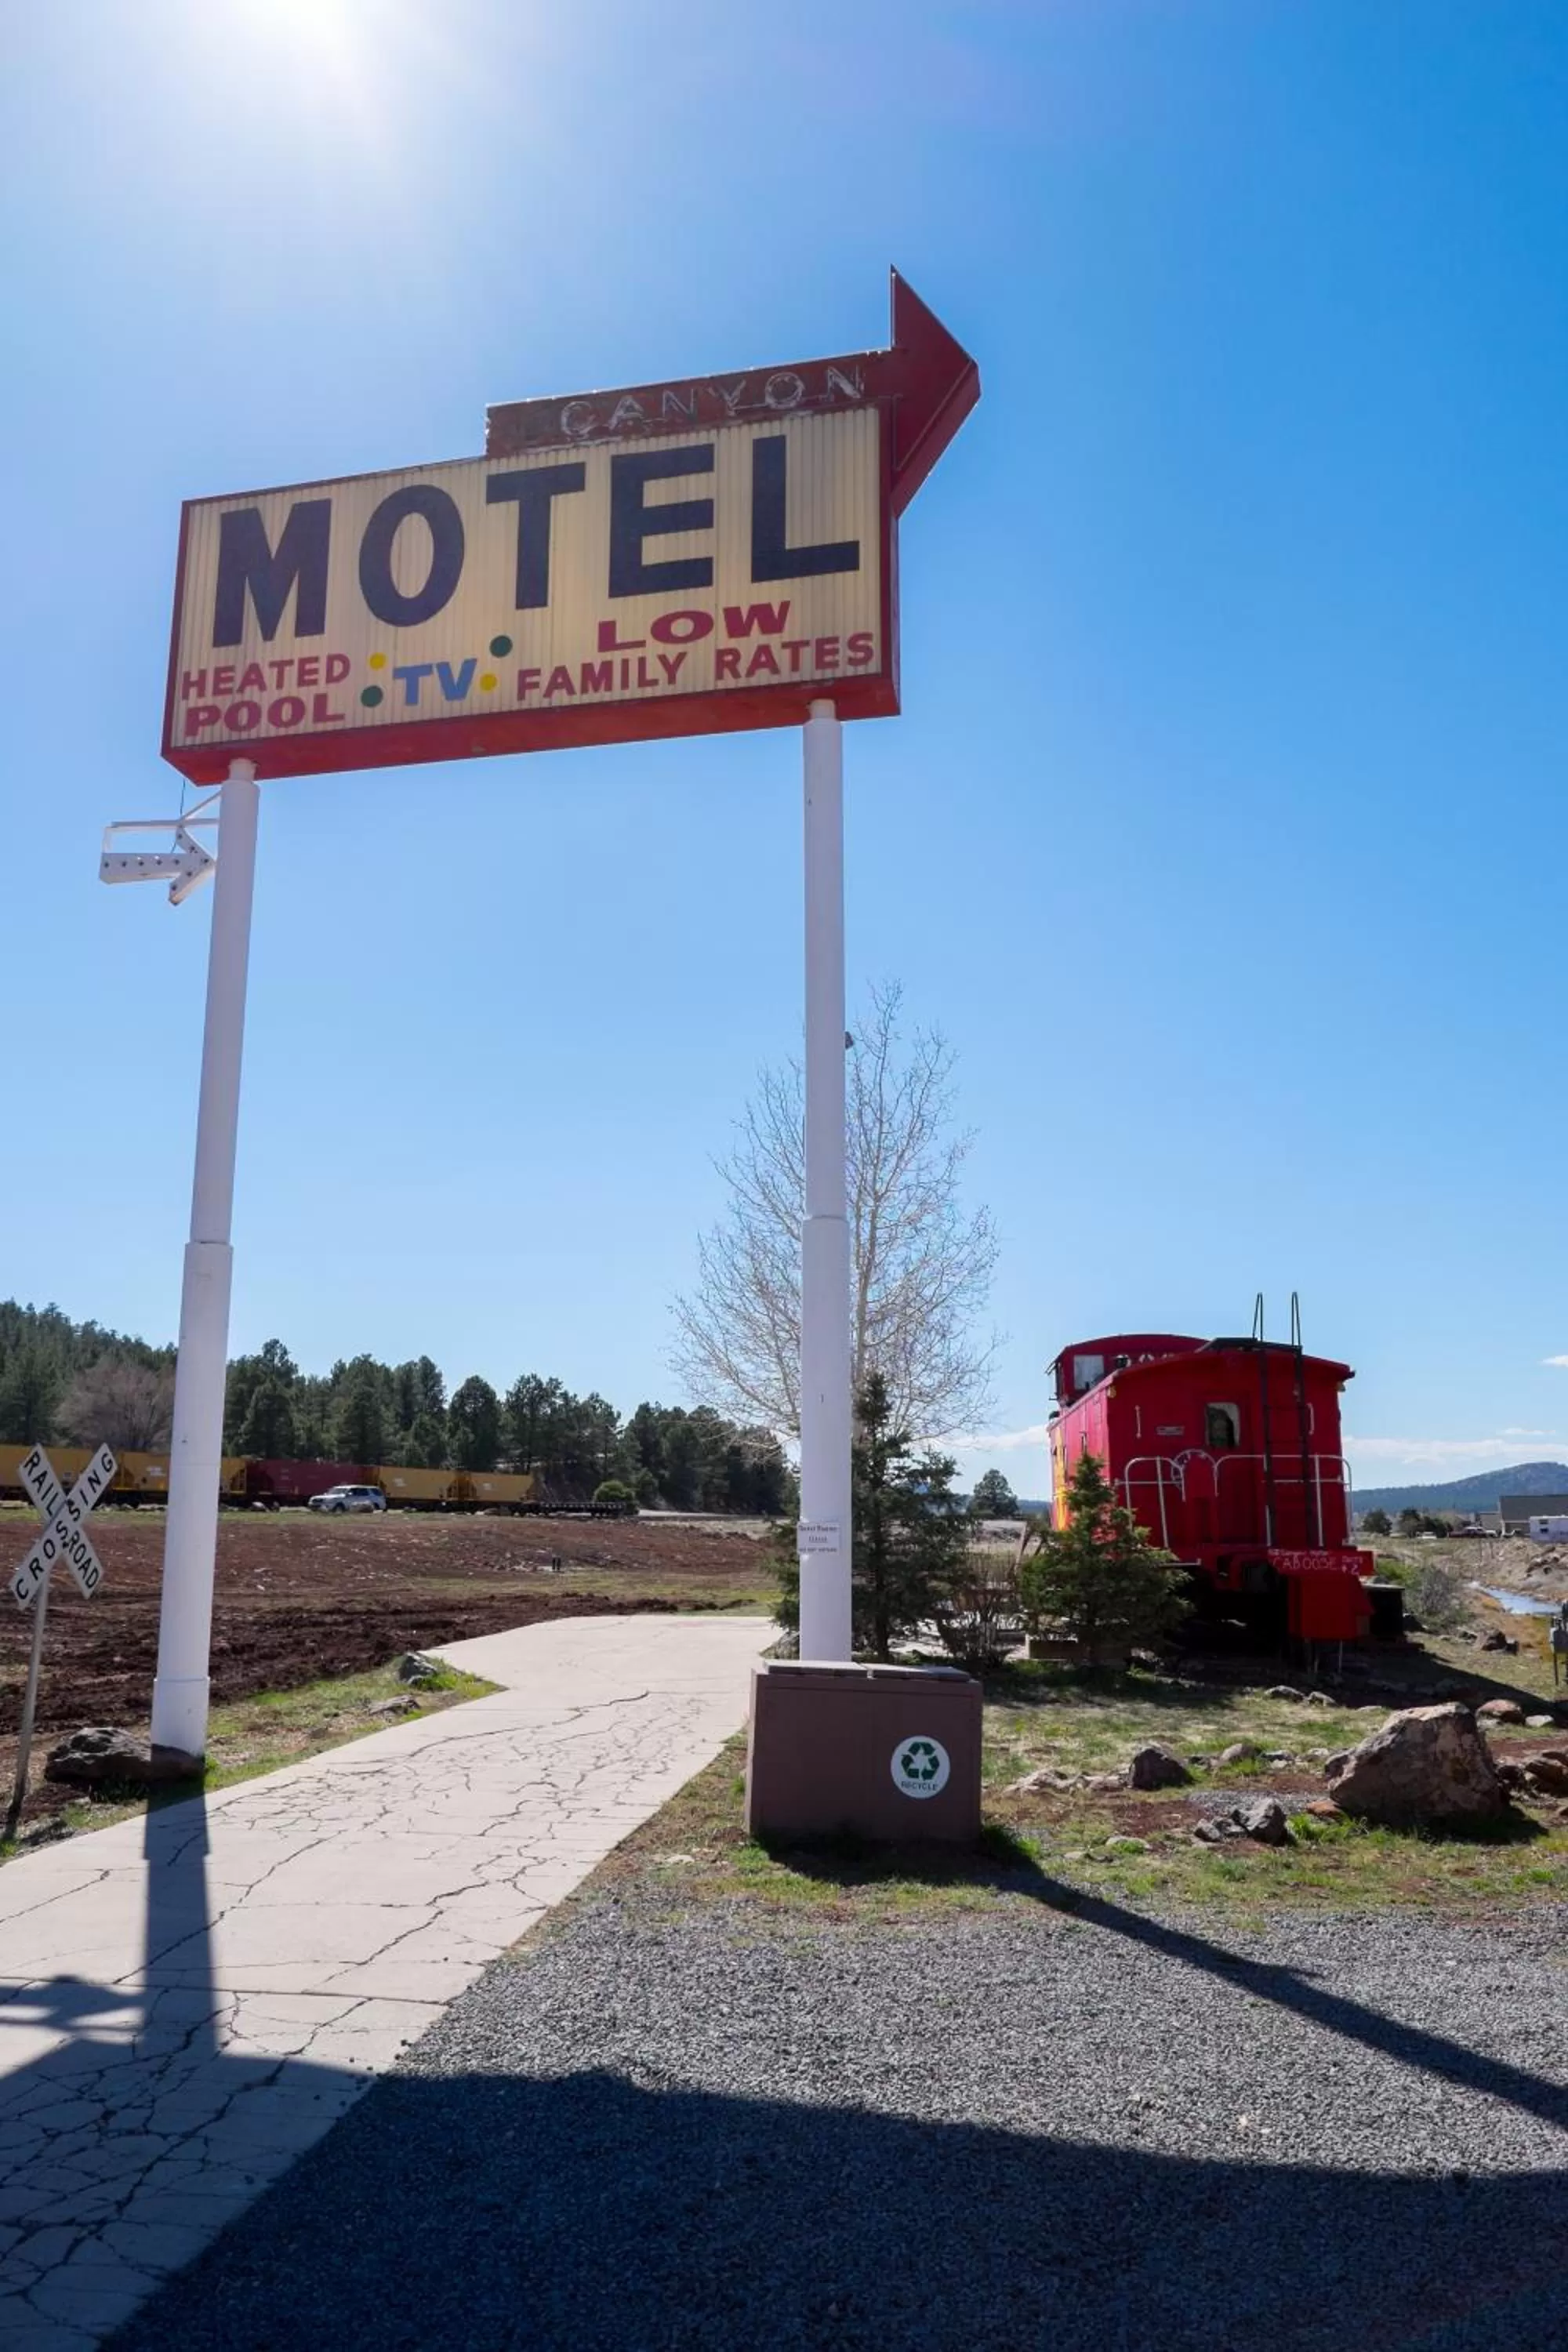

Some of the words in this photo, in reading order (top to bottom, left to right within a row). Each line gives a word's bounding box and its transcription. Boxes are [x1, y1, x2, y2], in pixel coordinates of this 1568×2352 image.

[561, 364, 863, 436] CANYON
[212, 434, 860, 649] MOTEL
[597, 600, 791, 653] LOW
[181, 653, 351, 701] HEATED
[393, 657, 477, 706] TV
[516, 652, 688, 702] FAMILY
[714, 632, 875, 681] RATES
[183, 692, 347, 738] POOL
[15, 1452, 114, 1600] CROSSING
[1272, 1555, 1338, 1572] CABOOSE
